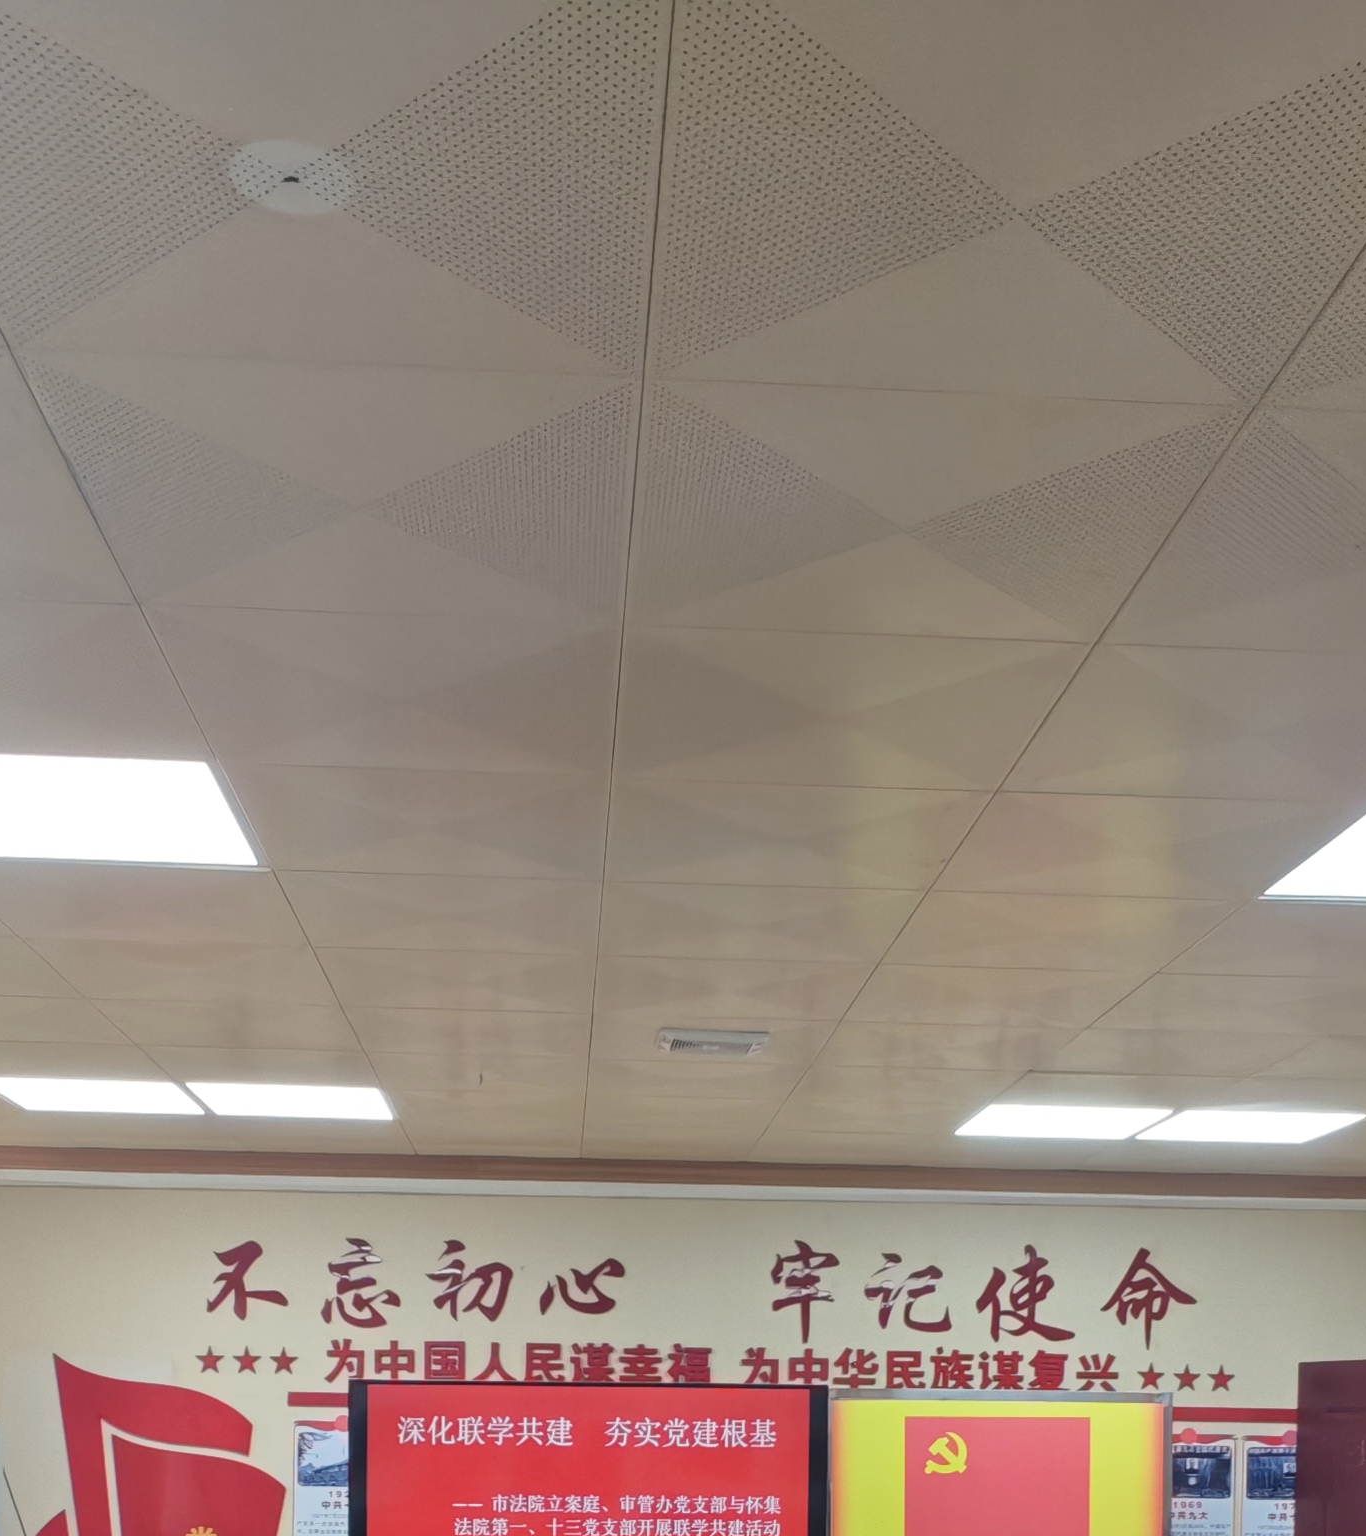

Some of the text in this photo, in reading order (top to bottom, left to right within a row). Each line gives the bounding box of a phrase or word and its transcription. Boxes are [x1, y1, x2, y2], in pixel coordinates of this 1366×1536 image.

[206, 1237, 1198, 1350] 不忘初心 牢记使命
[324, 1338, 1120, 1393] 为中国人民谋幸福 为中华民族谋复兴
[397, 1415, 778, 1449] 深化联学共建 夯实党建根基
